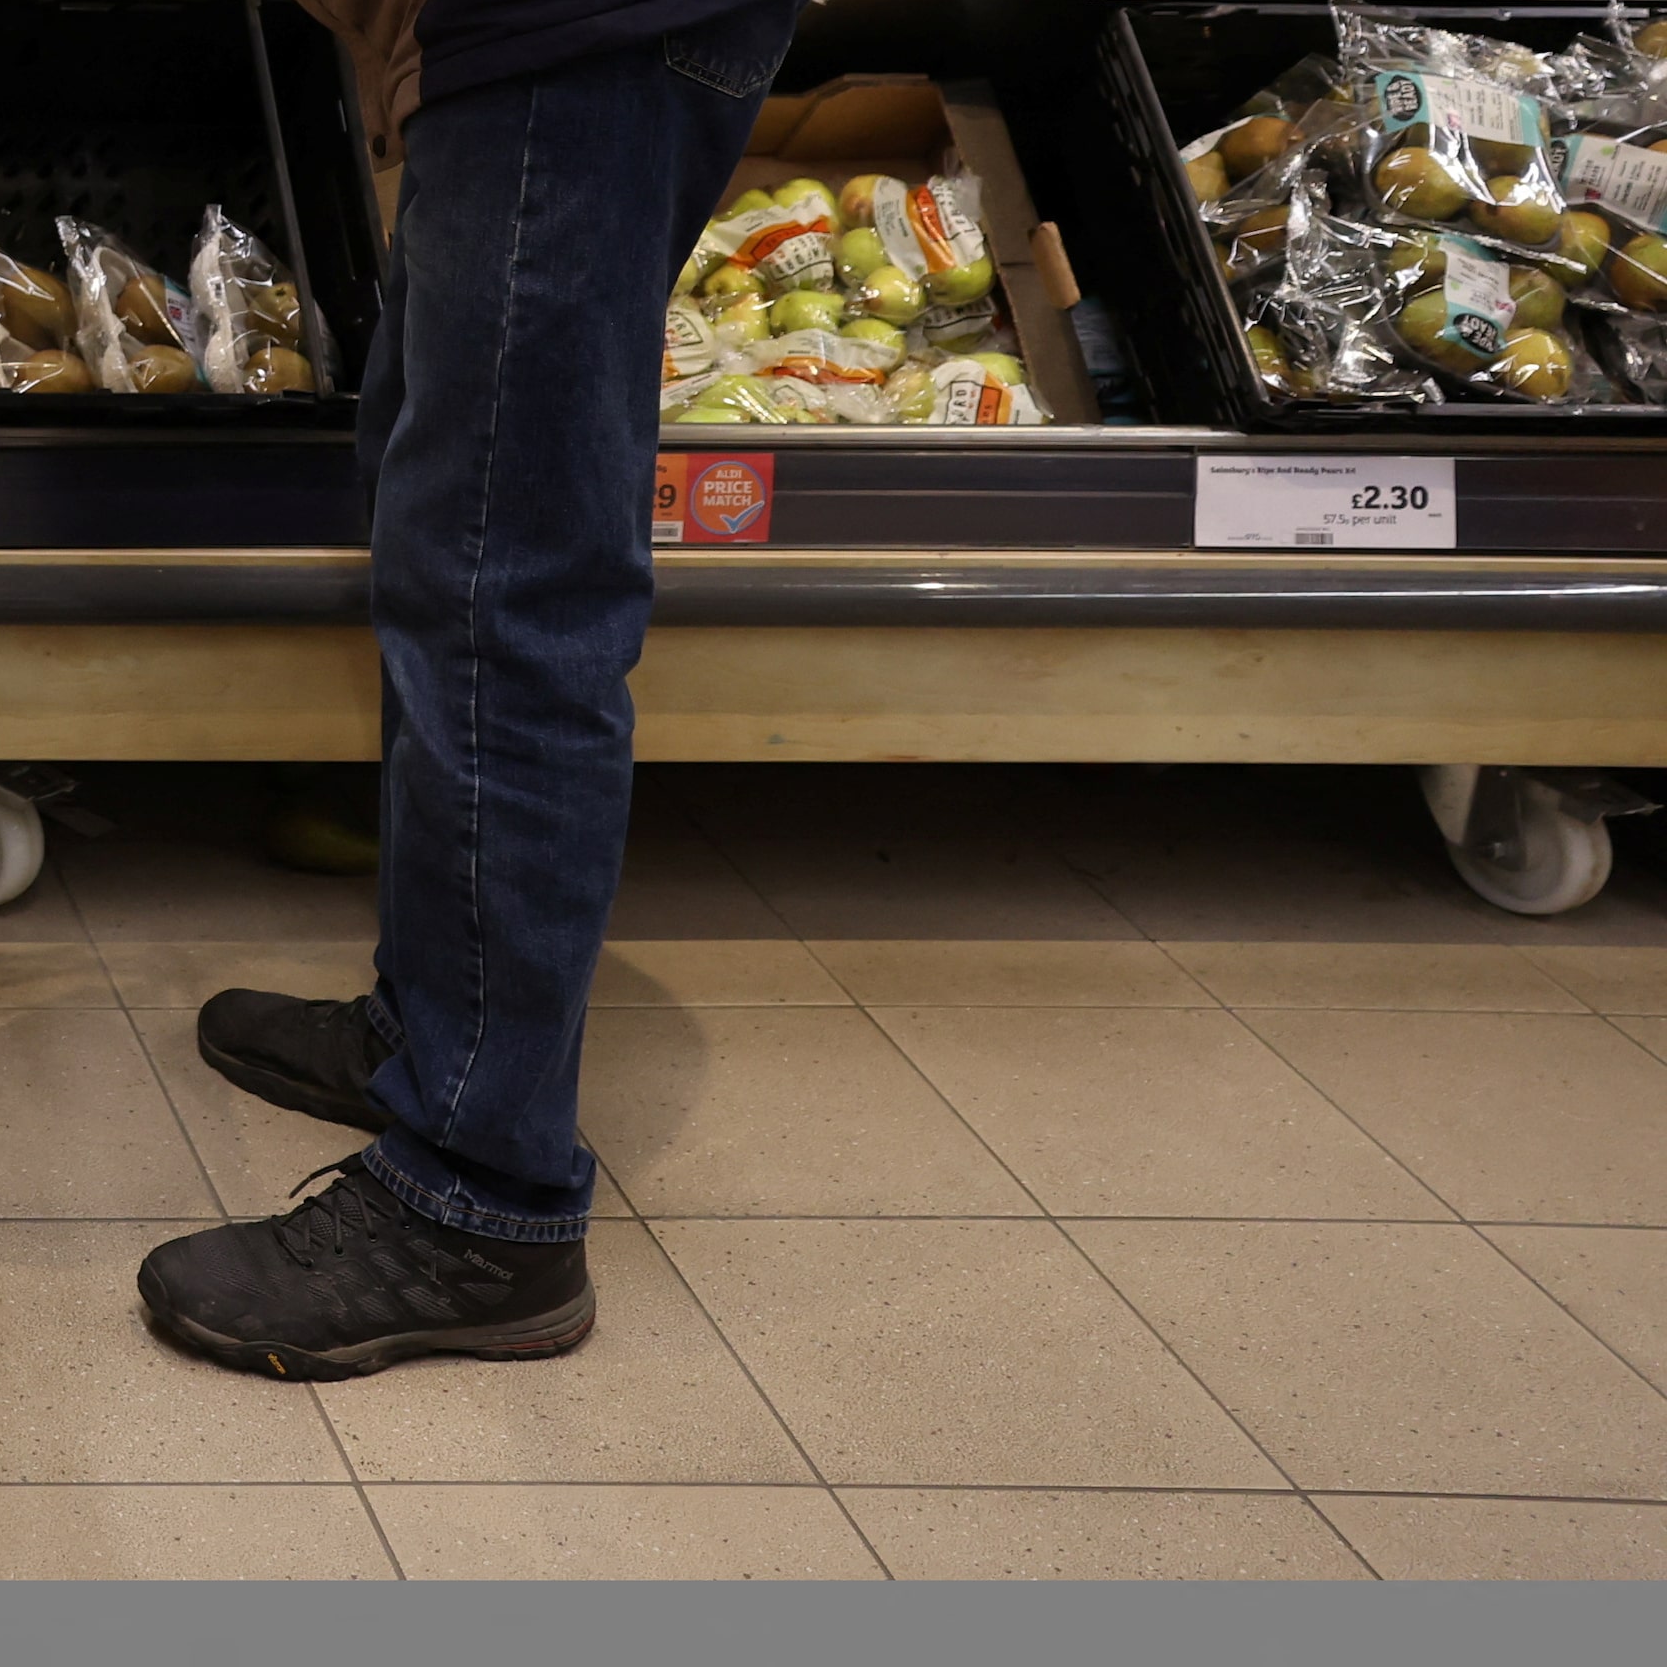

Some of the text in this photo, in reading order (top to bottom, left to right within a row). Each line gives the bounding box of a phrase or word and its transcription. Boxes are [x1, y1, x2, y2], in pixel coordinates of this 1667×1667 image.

[716, 469, 742, 479] ALDI
[1211, 466, 1256, 476] Sainsbury's
[1321, 466, 1344, 476] Pears
[703, 481, 753, 494] PRICE
[703, 495, 752, 506] MATCH
[1352, 485, 1429, 511] £2.30
[1352, 516, 1371, 526] per
[1373, 513, 1397, 524] unit
